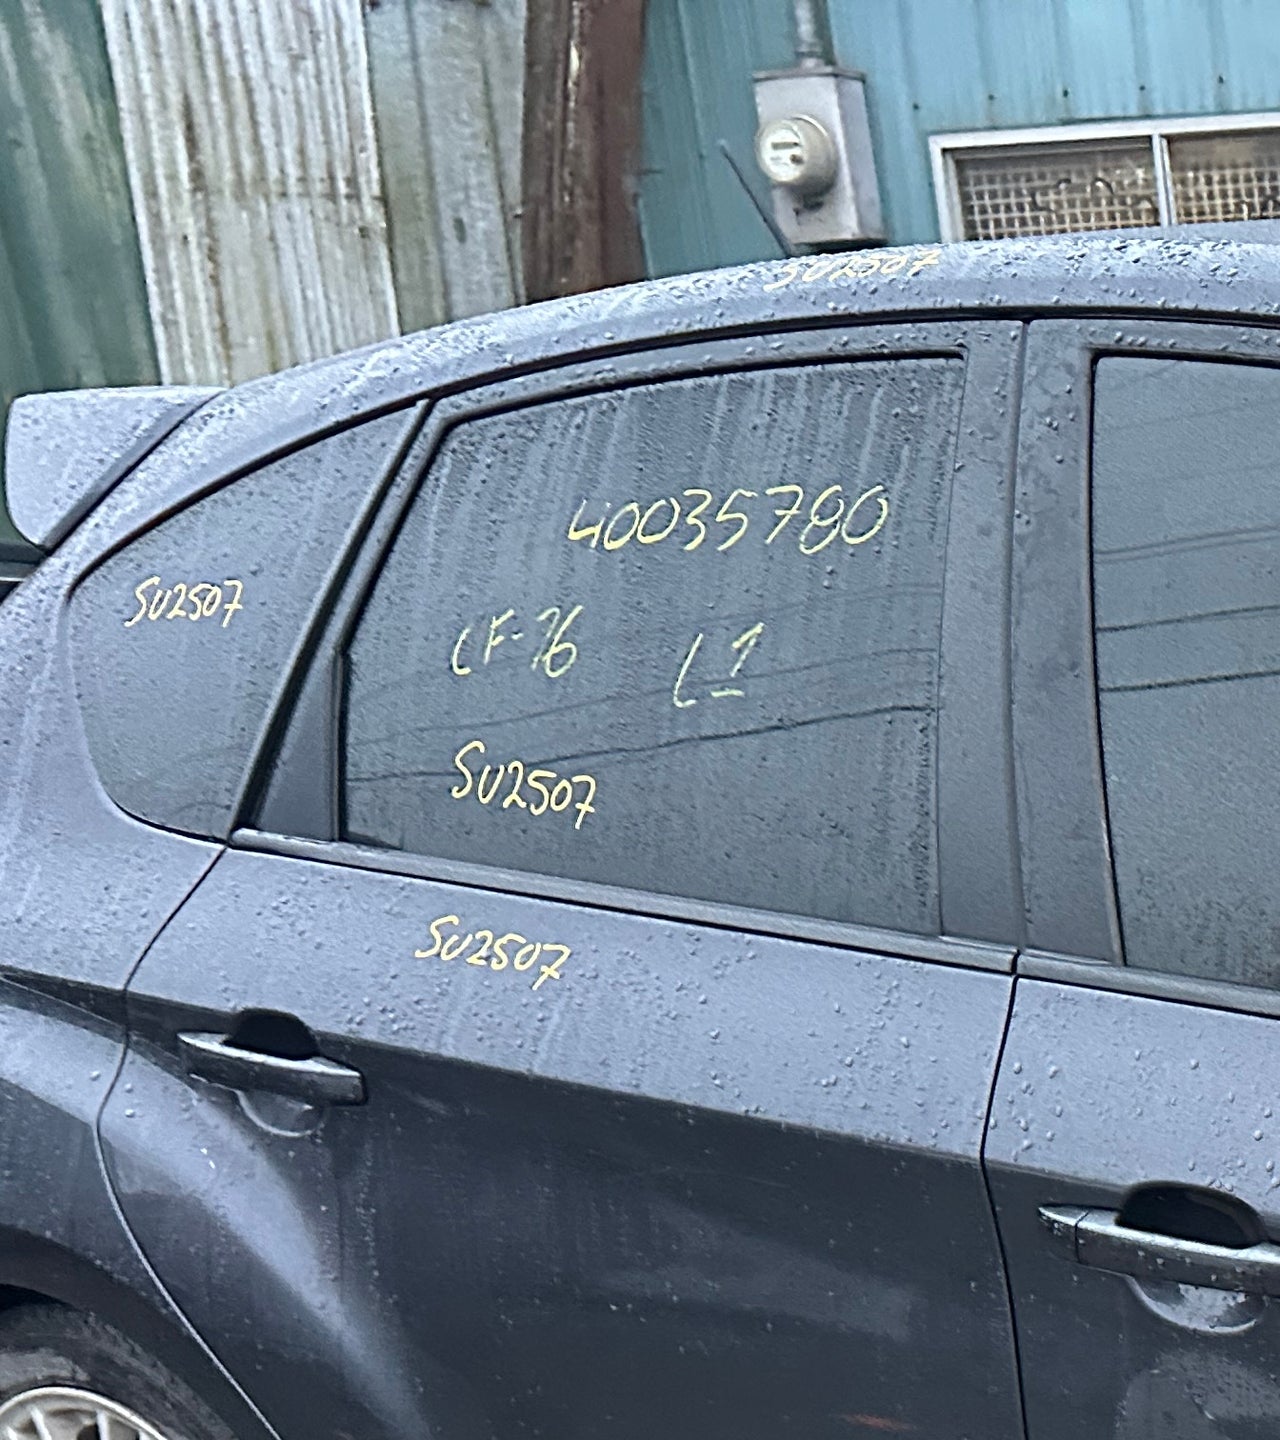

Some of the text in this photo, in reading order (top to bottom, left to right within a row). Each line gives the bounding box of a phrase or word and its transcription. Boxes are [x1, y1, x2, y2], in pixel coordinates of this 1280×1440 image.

[567, 484, 889, 555] 40035780
[123, 575, 244, 629] SU2507
[450, 740, 597, 831] SU2507
[414, 914, 572, 991] SU2507
